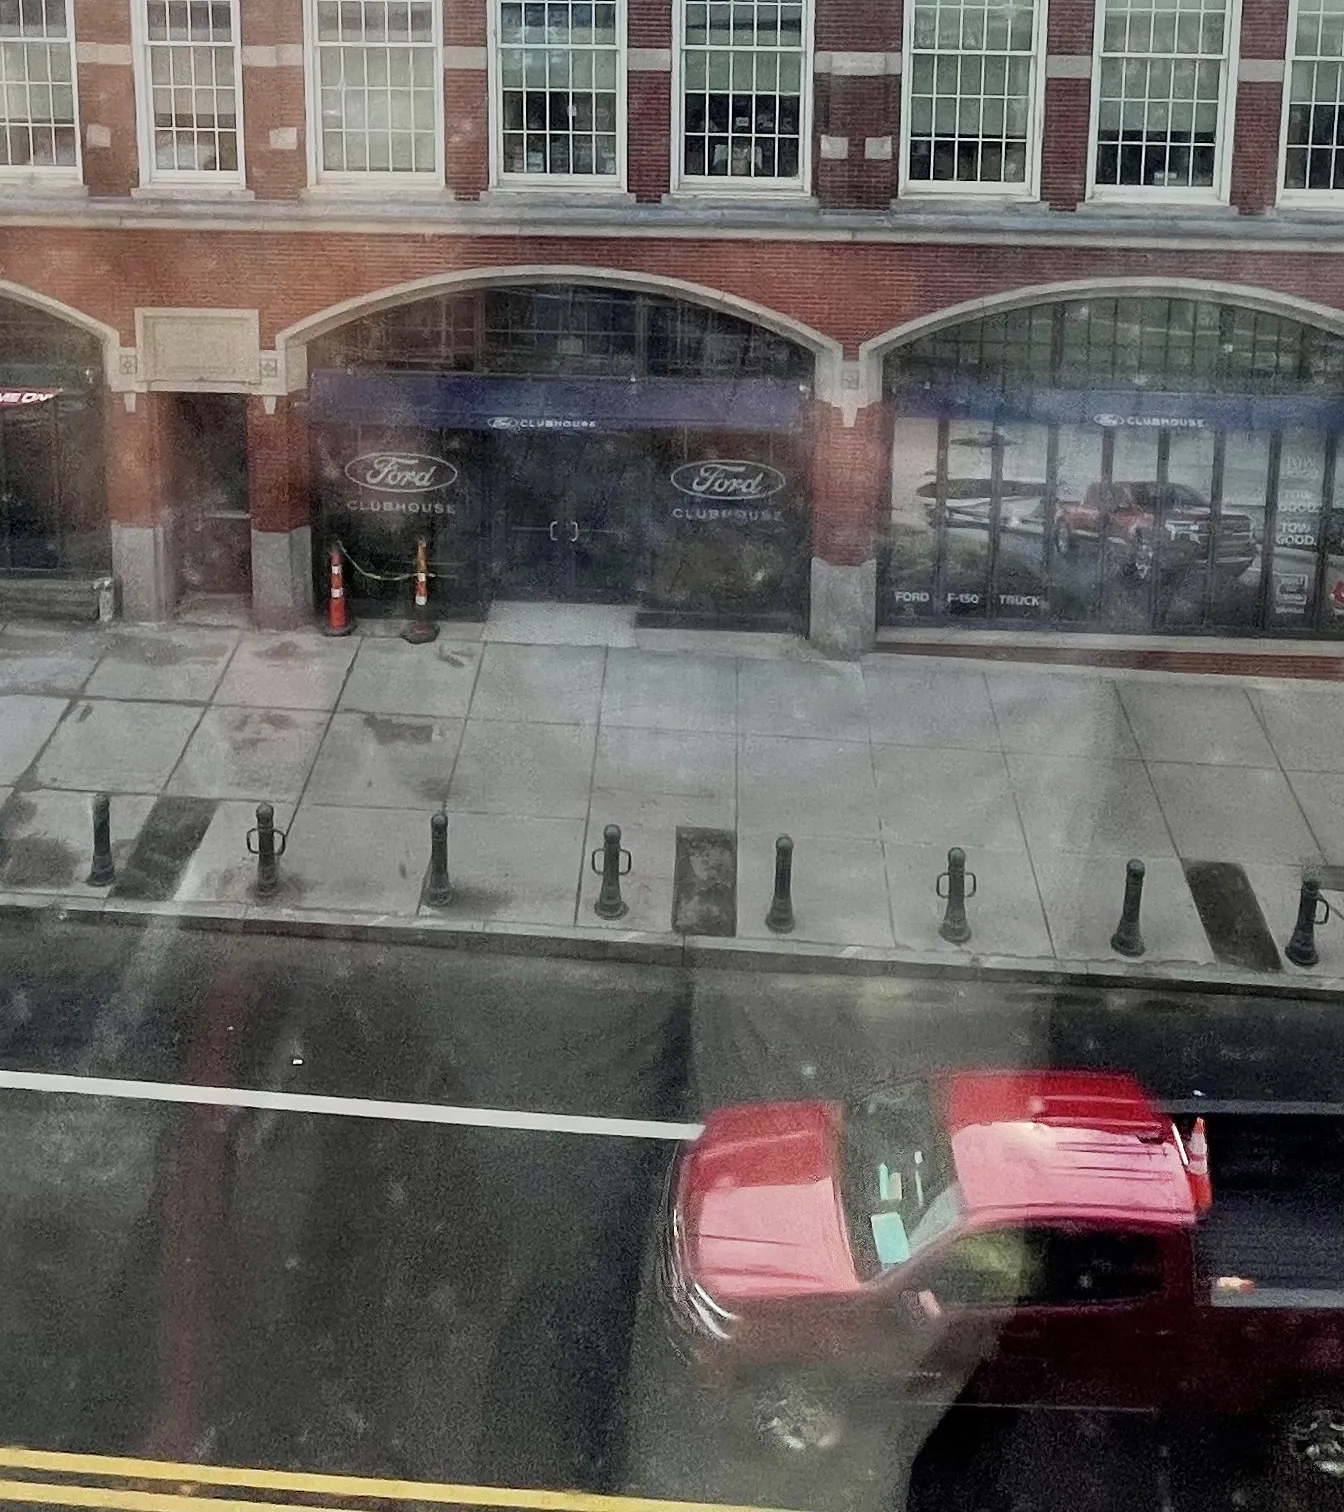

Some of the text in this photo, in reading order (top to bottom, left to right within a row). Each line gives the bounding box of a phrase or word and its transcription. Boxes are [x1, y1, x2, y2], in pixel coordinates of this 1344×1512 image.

[1126, 415, 1205, 428] CLUBHOUSE
[365, 455, 437, 487] Ford
[692, 463, 764, 494] Ford
[347, 500, 457, 514] CLUBHOUSE
[672, 508, 783, 522] CLUBHOUSE
[895, 591, 1041, 606] FORD F-150 TRUCK
